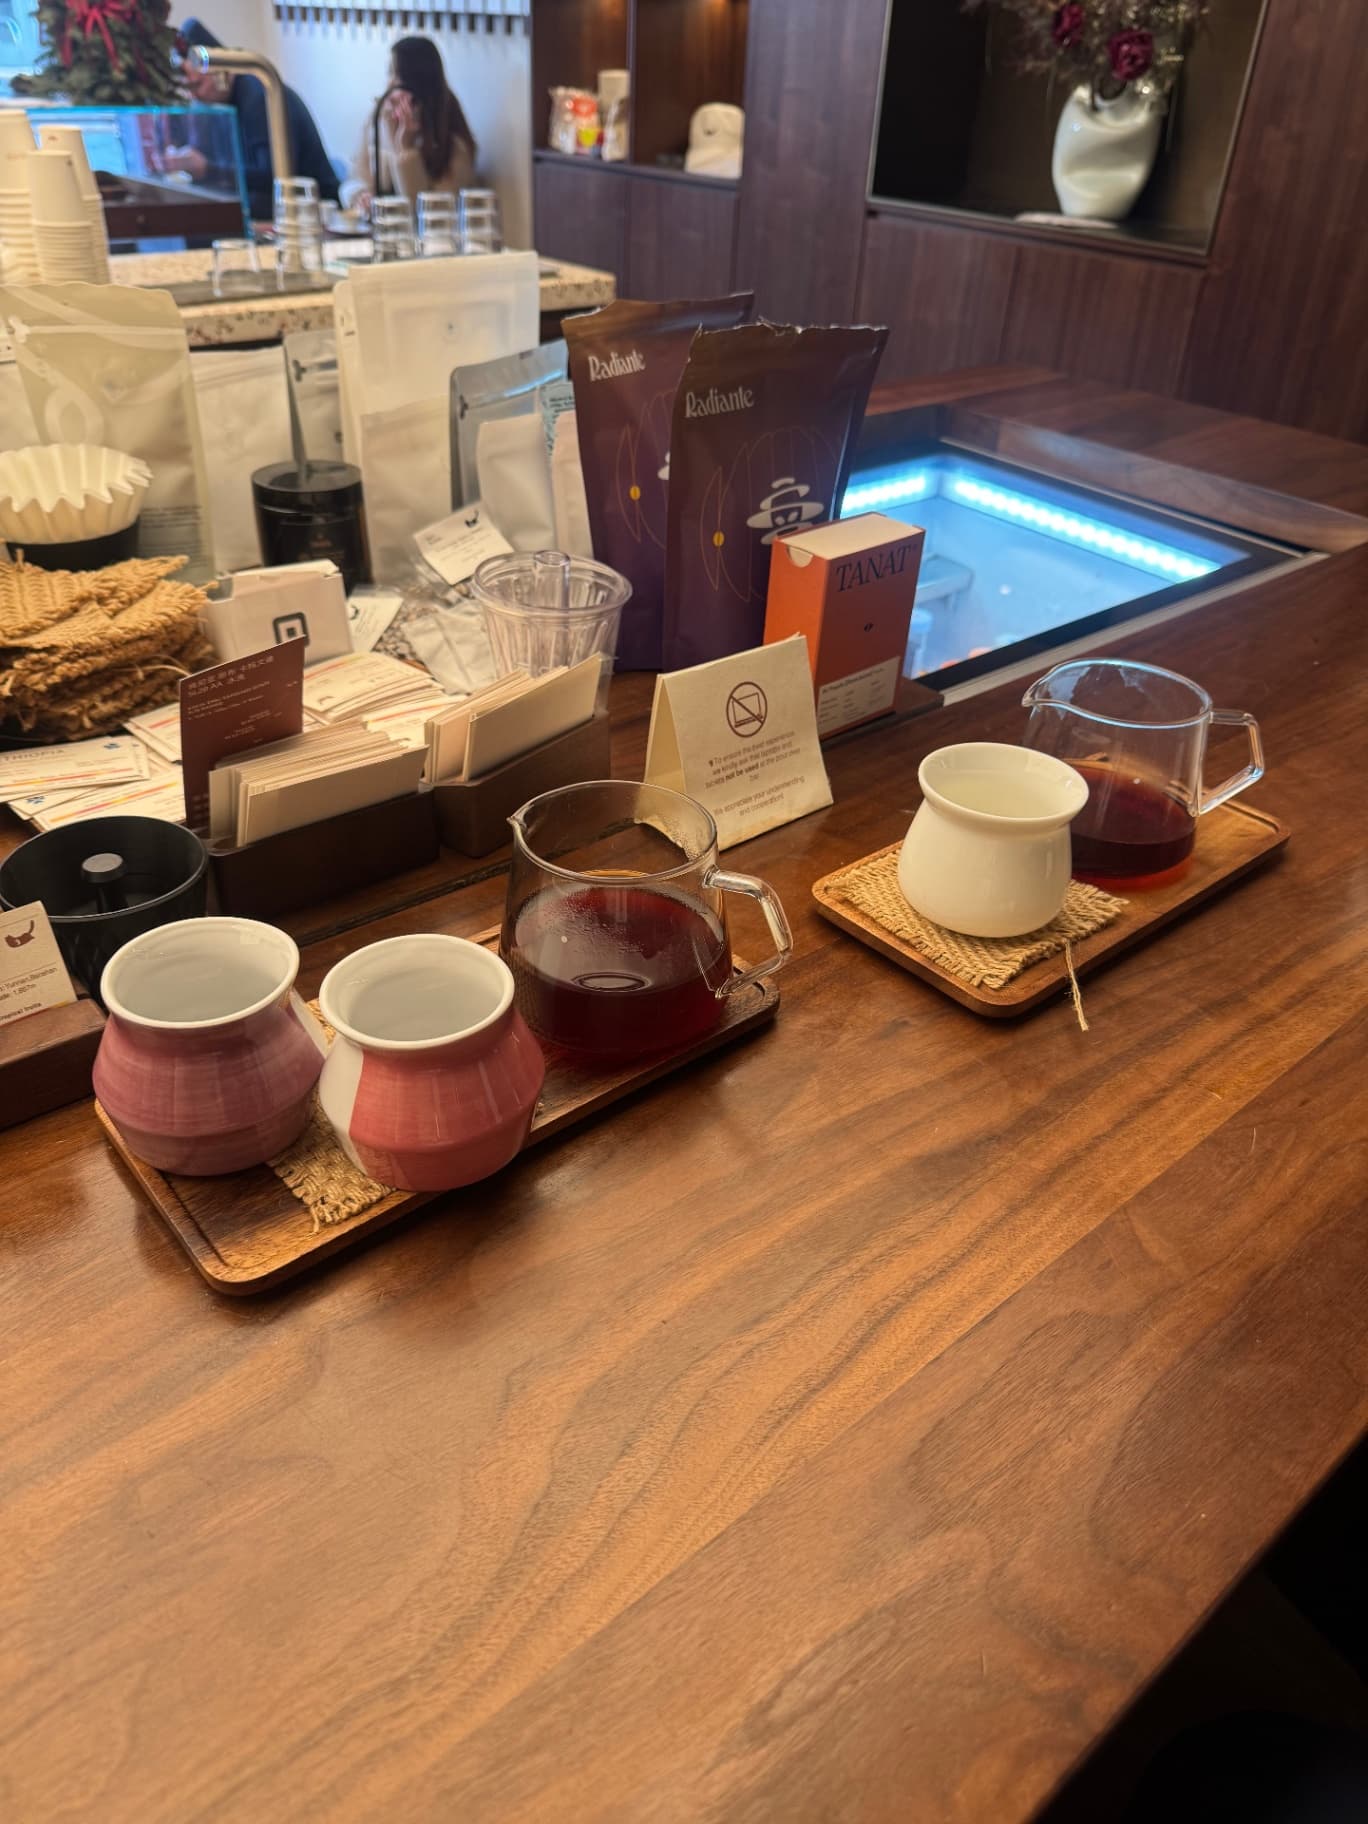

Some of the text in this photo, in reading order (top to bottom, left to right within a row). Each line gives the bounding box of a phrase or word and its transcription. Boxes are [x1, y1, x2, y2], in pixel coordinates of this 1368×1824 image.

[588, 348, 646, 382] Radiante
[685, 386, 754, 418] Radiante
[836, 544, 912, 592] TANAT
[726, 772, 735, 780] not
[745, 762, 759, 773] used
